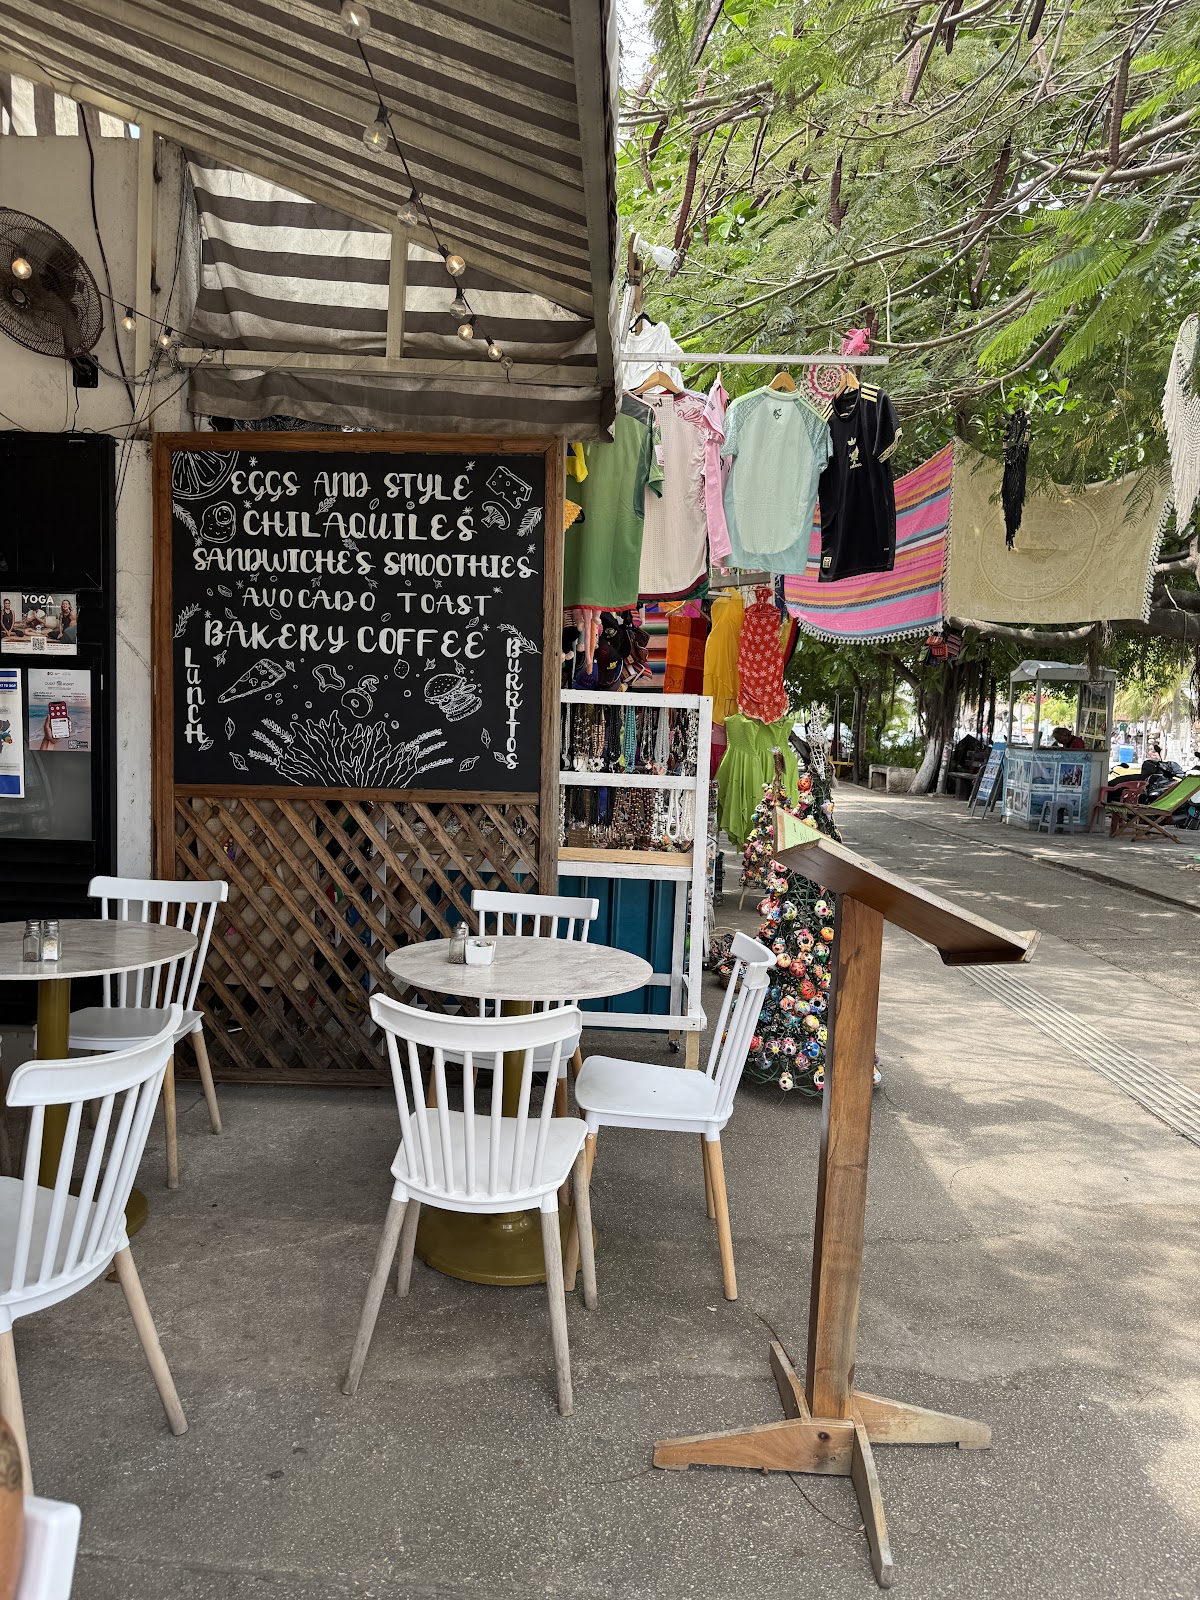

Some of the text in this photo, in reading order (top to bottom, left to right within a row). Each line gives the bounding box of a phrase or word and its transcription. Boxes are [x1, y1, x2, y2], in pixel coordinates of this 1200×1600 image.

[231, 470, 474, 503] EGGS AND STYLE
[243, 510, 477, 541] CHILAQUILES
[193, 547, 538, 578] SANDWICHES SMOOTHIES
[22, 595, 54, 604] YOGA
[242, 586, 493, 617] AVOCADO TOAST
[204, 619, 486, 659] BAKERY COFFEE
[505, 637, 525, 770] BURRITOS
